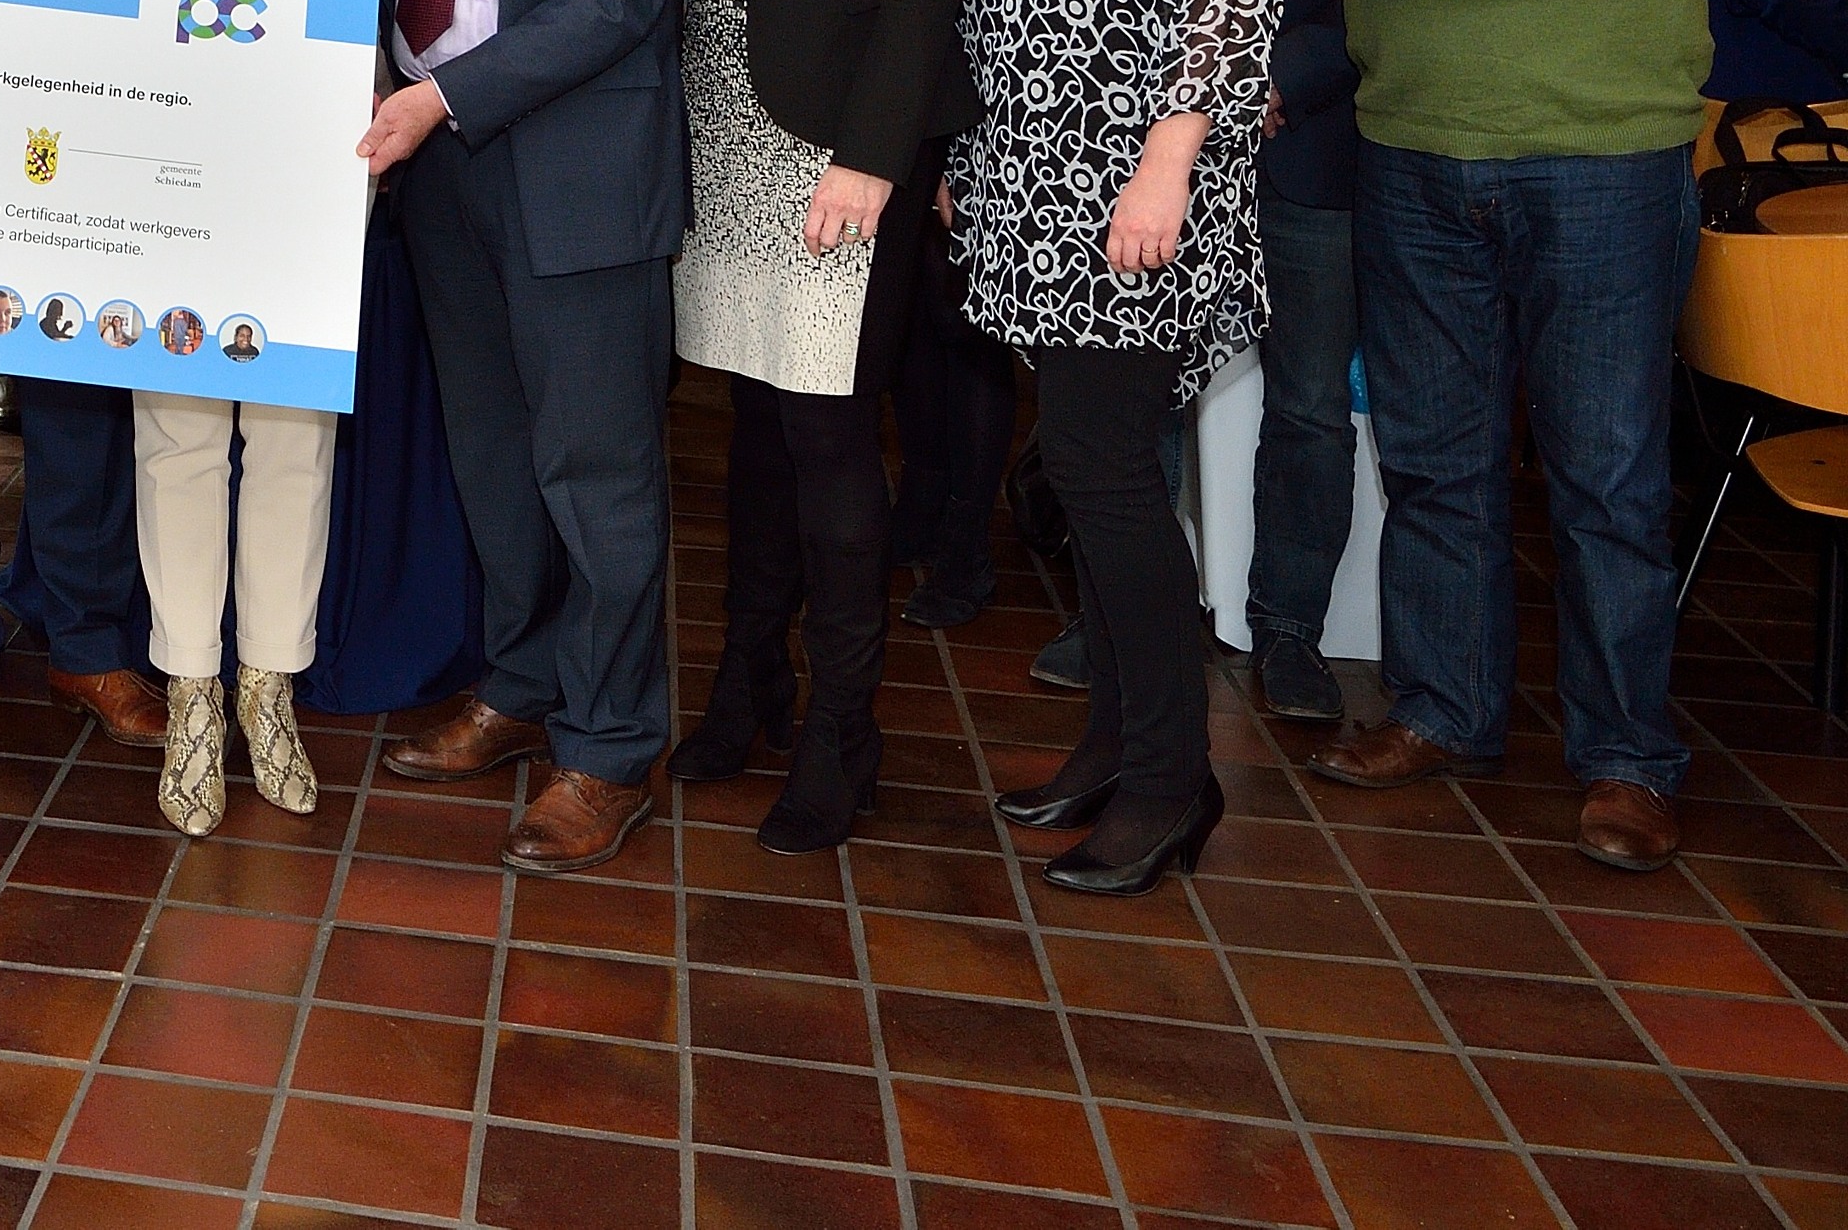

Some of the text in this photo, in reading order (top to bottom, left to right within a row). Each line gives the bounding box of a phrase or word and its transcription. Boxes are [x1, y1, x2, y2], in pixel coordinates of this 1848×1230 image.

[108, 83, 122, 98] in
[125, 85, 145, 101] de
[149, 90, 192, 107] regio.
[154, 175, 201, 189] Schiedam
[159, 165, 202, 176] gemeente
[4, 203, 81, 227] Certificaat,
[85, 214, 125, 230] zodat
[129, 220, 210, 240] werkgevers
[8, 228, 143, 256] arbeidsparticipatie.
